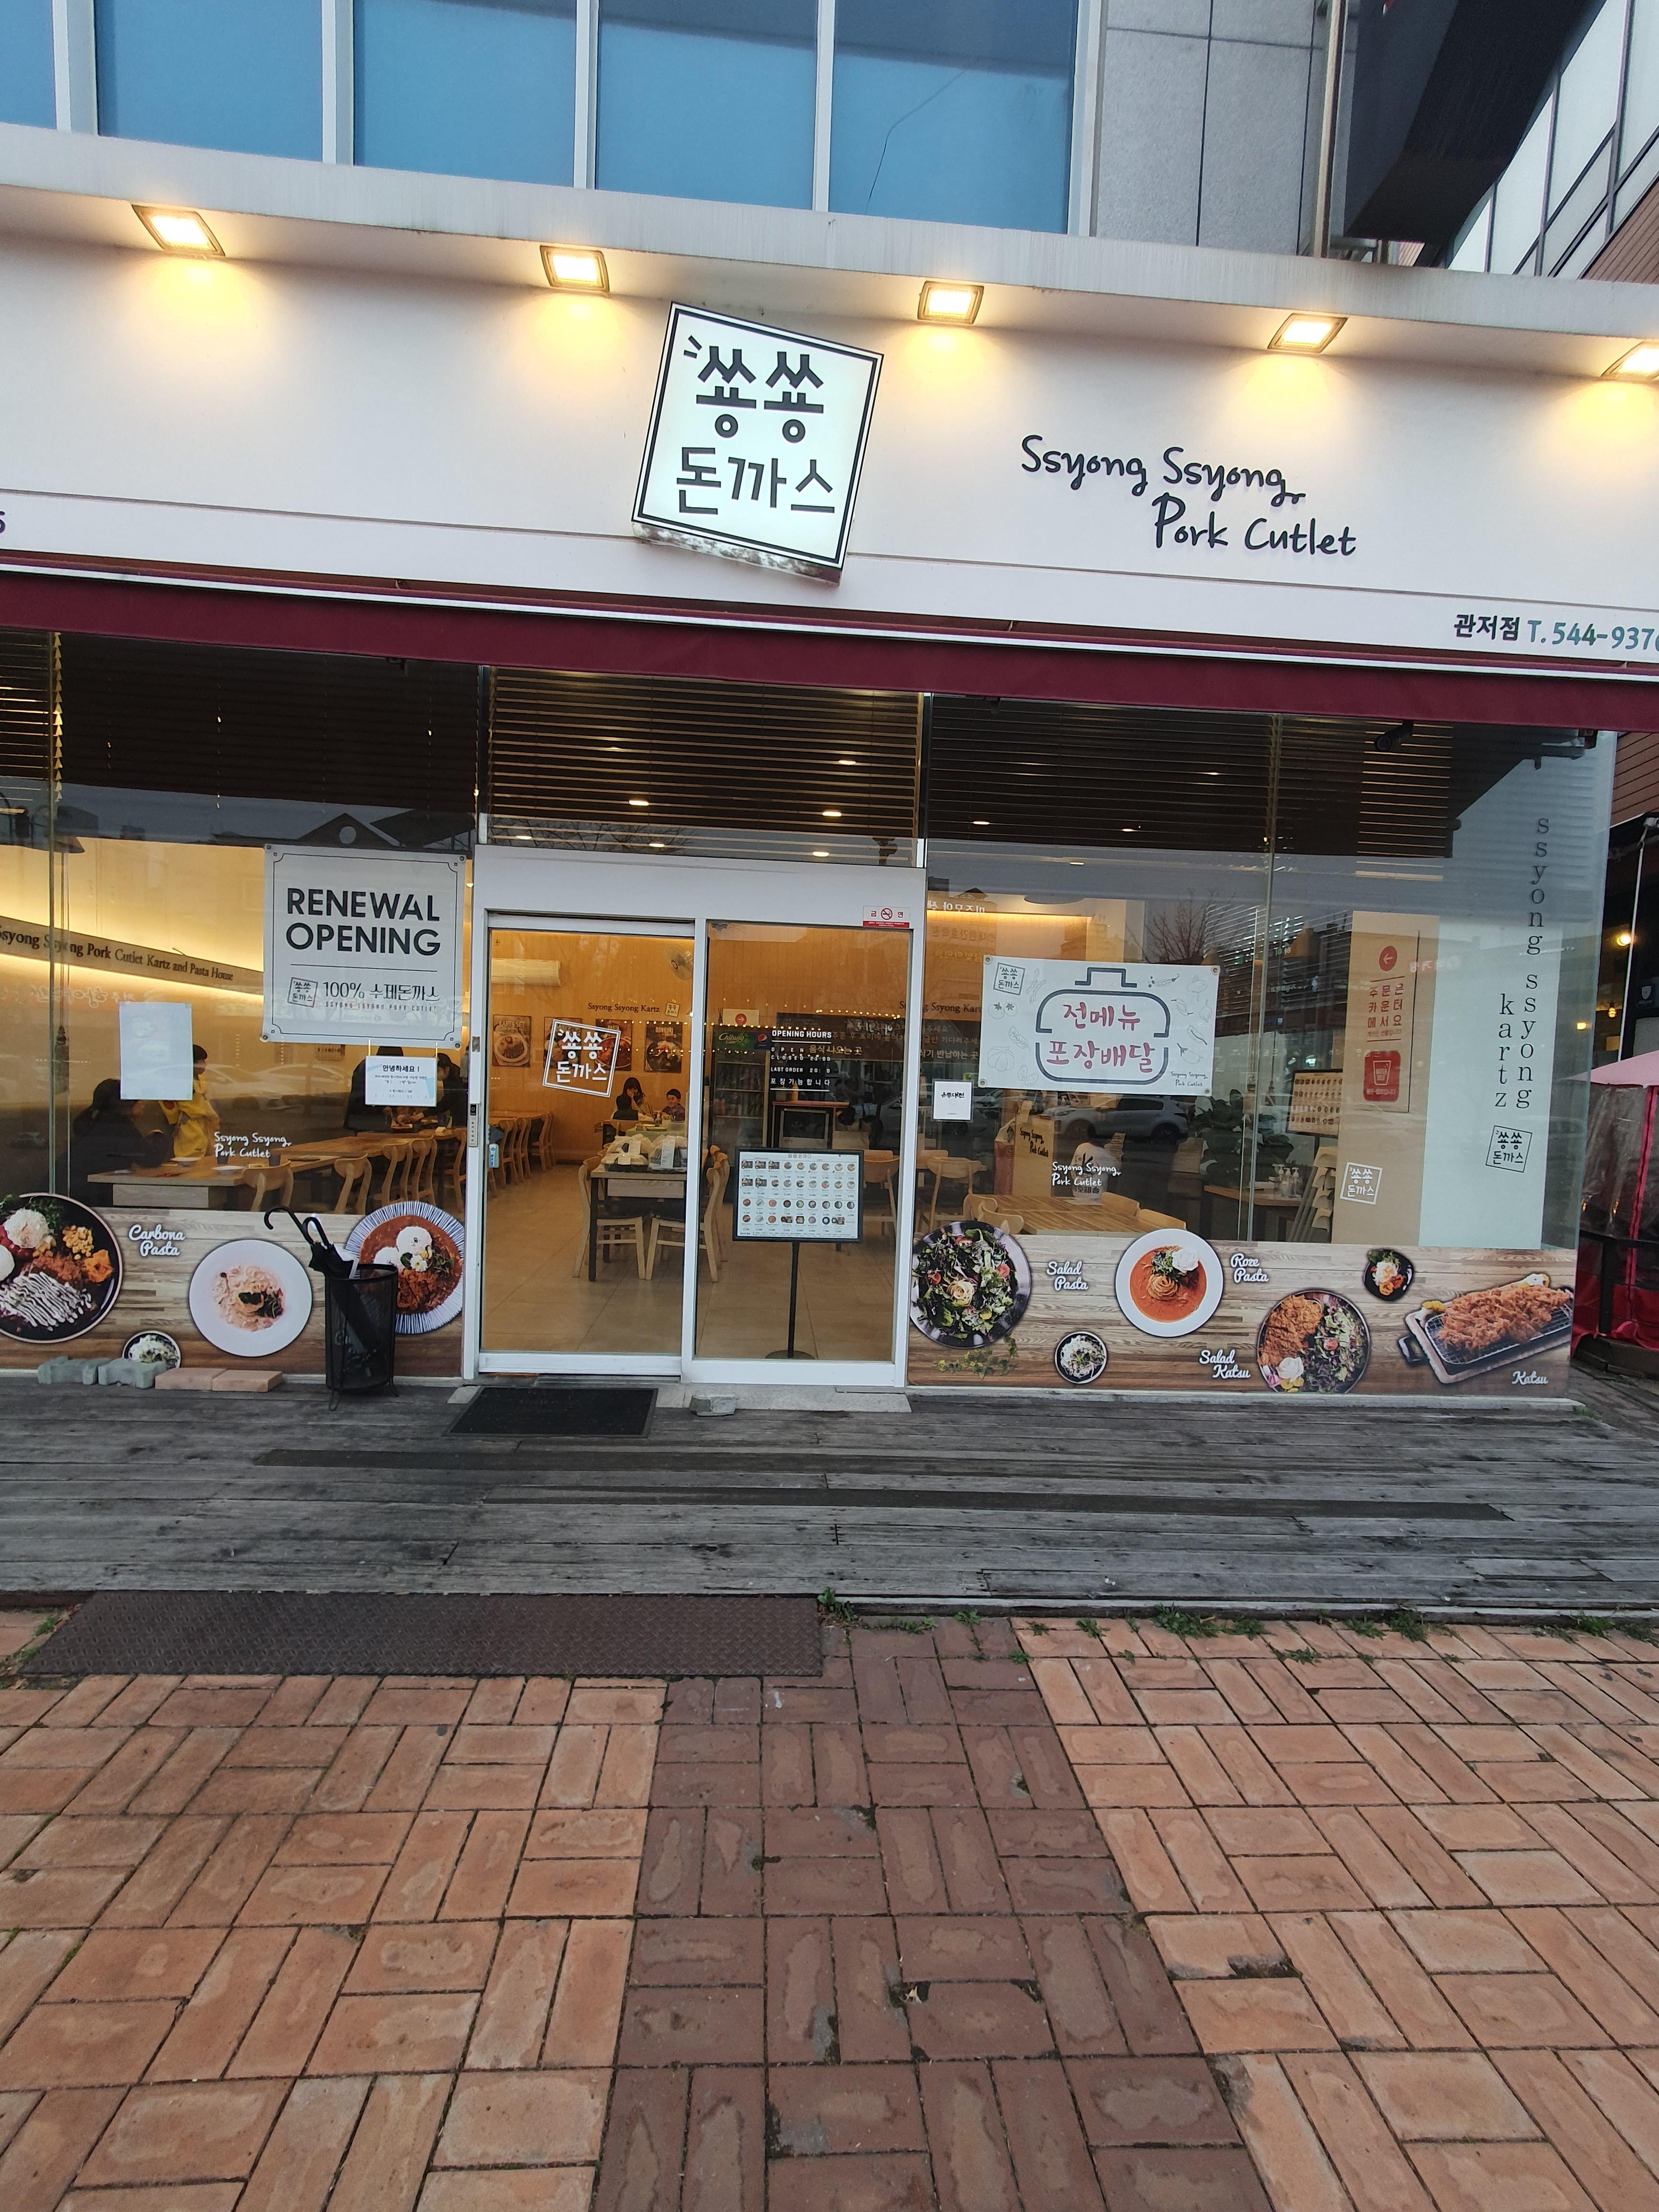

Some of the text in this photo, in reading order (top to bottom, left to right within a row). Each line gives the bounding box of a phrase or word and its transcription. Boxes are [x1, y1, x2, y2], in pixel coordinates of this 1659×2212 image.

[696, 345, 824, 443] 쑝쑝
[1022, 435, 1306, 507] Ssyong Ssyong
[676, 447, 835, 515] 돈까스
[1152, 493, 1356, 555] Pork Cutlet
[1454, 614, 1520, 641] 관저점
[288, 888, 440, 922] RENEWAL
[286, 922, 441, 956] OPENING
[87, 942, 111, 960] Pork
[114, 949, 143, 965] Cutlet
[146, 954, 170, 970] Kartz
[172, 959, 187, 974] and
[190, 962, 209, 977] Pasta
[211, 967, 234, 981] House
[1516, 818, 1550, 1109] ssyong ssyong
[323, 982, 440, 1001] 100% 수제돈까스
[998, 980, 1020, 989] 돈까스
[1369, 983, 1404, 998] 주문은
[292, 993, 313, 1002] 돈까스
[588, 1003, 660, 1013] Ssyong Ssyong Kartz
[1368, 999, 1403, 1013] 카운터
[1062, 1002, 1141, 1032] 전메뉴
[809, 1045, 863, 1055] 음식 나오는 곳
[937, 1050, 968, 1059] 반납하는
[1046, 1040, 1155, 1073] 포장배달
[1495, 993, 1515, 1107] kartz
[556, 1061, 607, 1083] 돈까스
[214, 1131, 292, 1148] Ssyong Ssyong
[214, 1143, 271, 1158] Pork Cutlet
[1493, 1151, 1523, 1165] 돈까스
[1052, 1161, 1121, 1177] Ssyong Ssyong
[1051, 1172, 1102, 1186] Pork Cutlet
[1347, 1185, 1374, 1197] 돈까스
[129, 1224, 185, 1241] Carbona
[140, 1240, 180, 1257] Pasta
[1046, 1261, 1082, 1276] Salad
[1230, 1253, 1260, 1268] Roze
[1054, 1277, 1089, 1291] Pasta
[1233, 1268, 1269, 1284] Pasta
[1199, 1349, 1235, 1365] Salad
[1212, 1364, 1251, 1380] Katsu
[1512, 1370, 1549, 1385] Katsu
